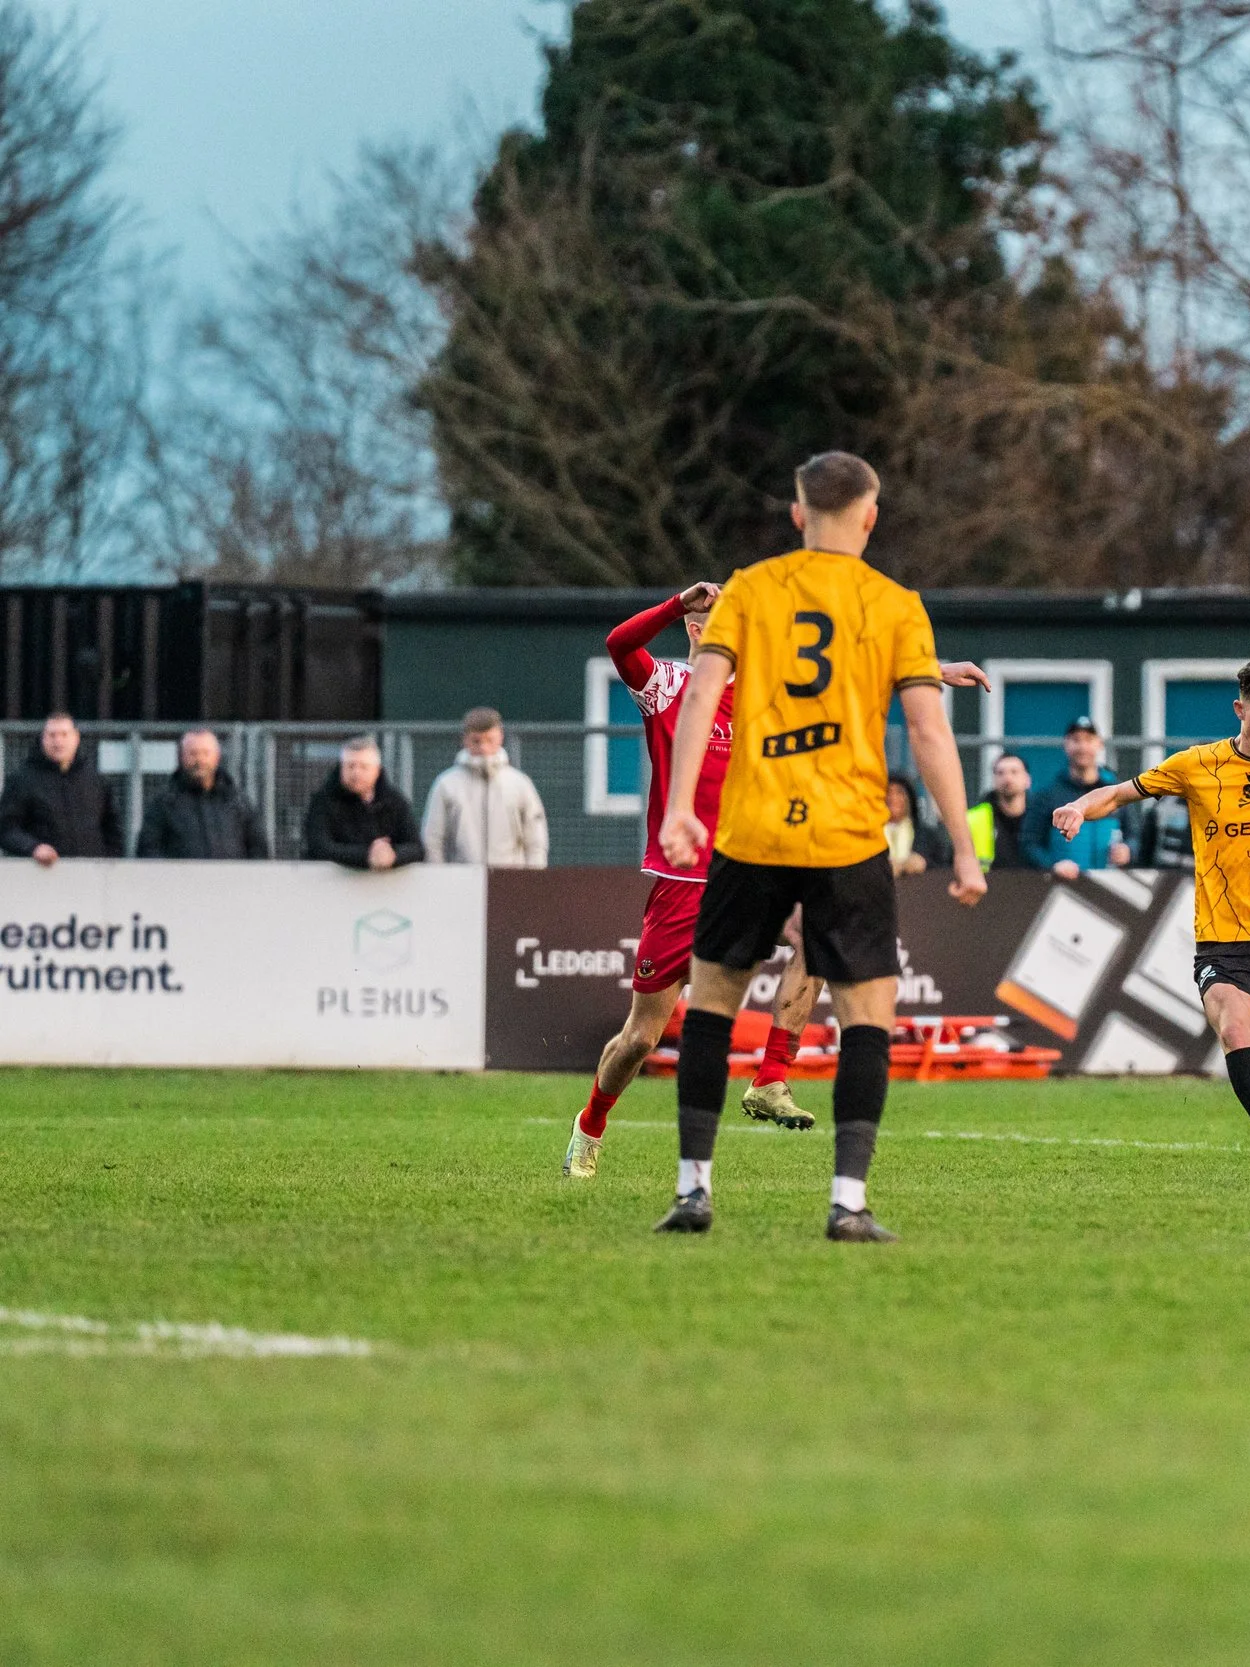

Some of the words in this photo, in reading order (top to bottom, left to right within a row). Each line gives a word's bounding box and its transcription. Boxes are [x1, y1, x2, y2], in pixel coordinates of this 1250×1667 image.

[784, 611, 834, 698] 3
[132, 912, 168, 950] in
[532, 949, 625, 976] LEDGER
